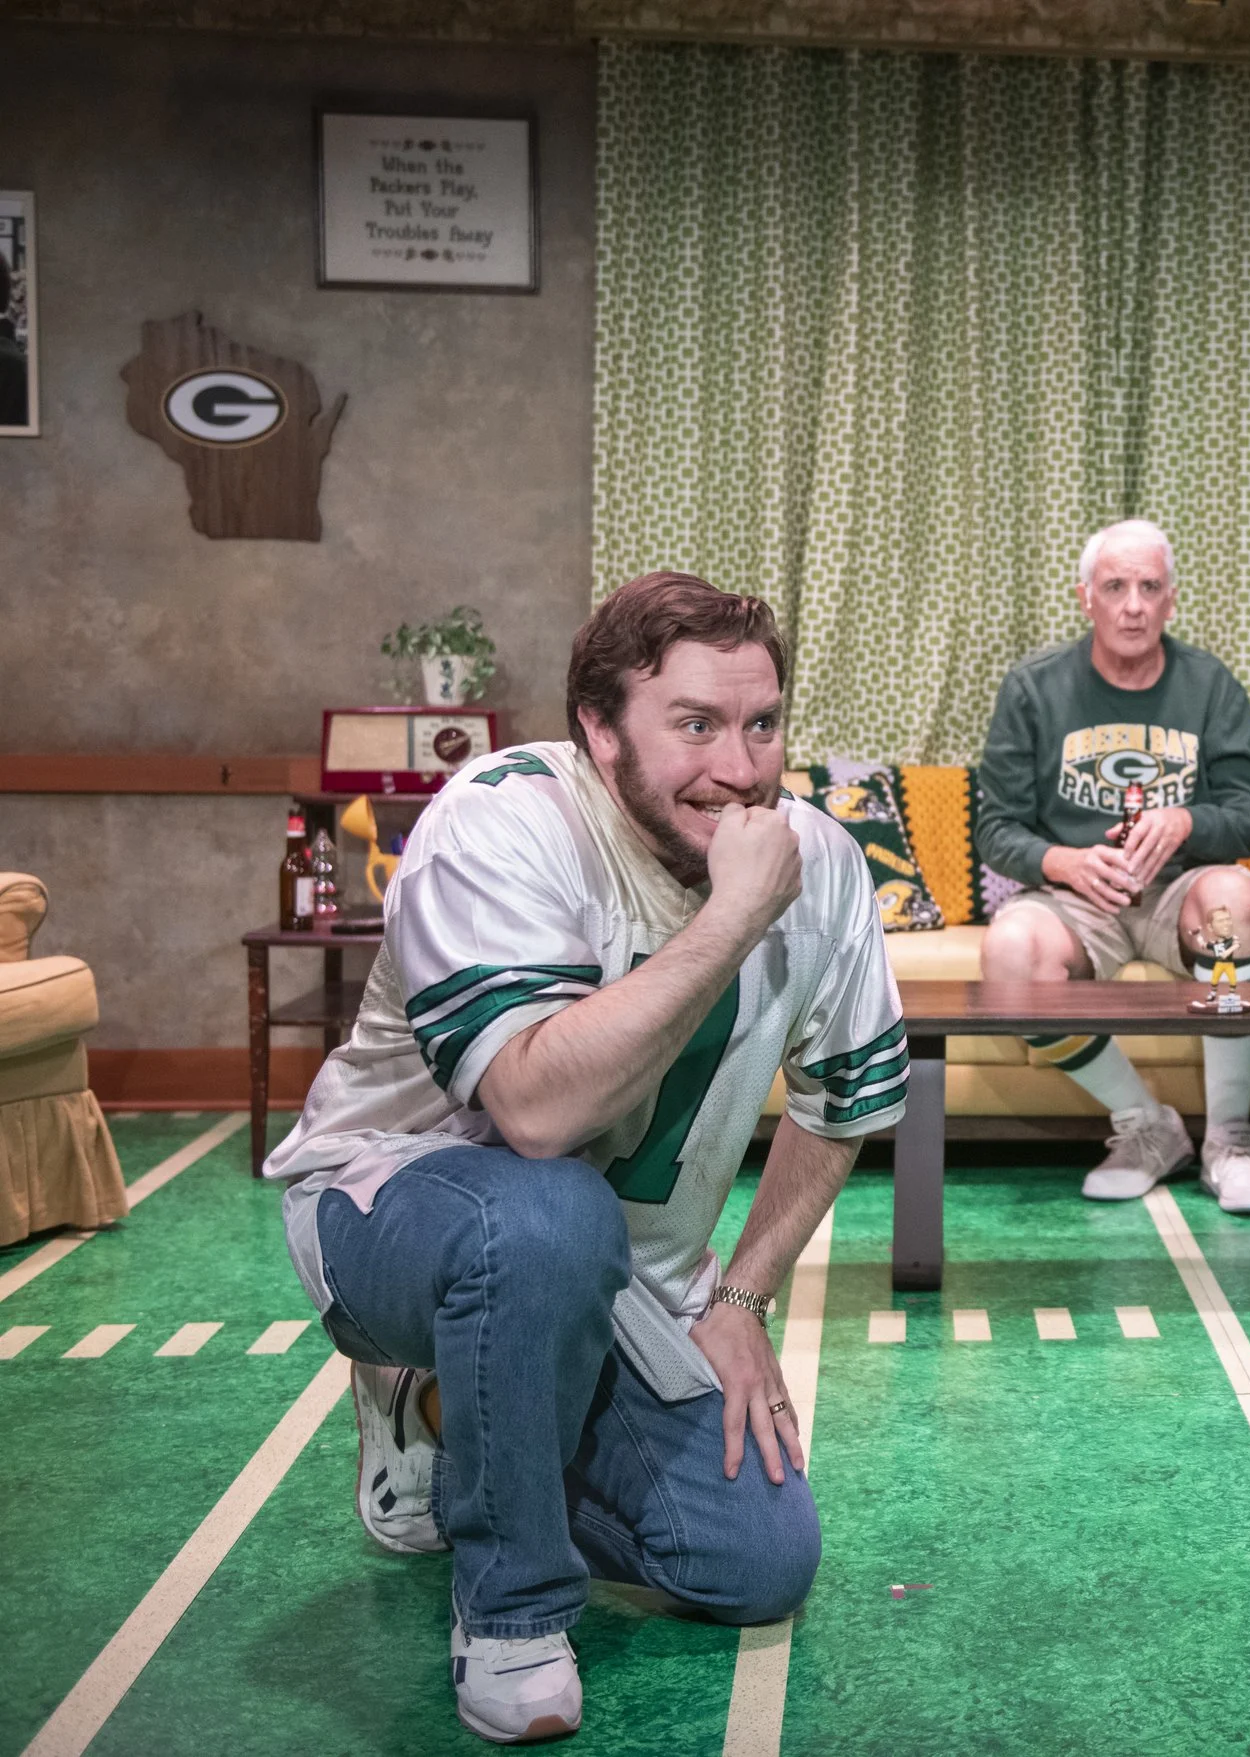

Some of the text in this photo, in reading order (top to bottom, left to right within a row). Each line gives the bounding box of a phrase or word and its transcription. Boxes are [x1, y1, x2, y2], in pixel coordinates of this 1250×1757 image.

[381, 155, 464, 175] When the
[370, 176, 431, 195] Packers
[384, 199, 459, 218] Put Your
[365, 221, 494, 248] Troubles Away
[167, 372, 281, 443] G
